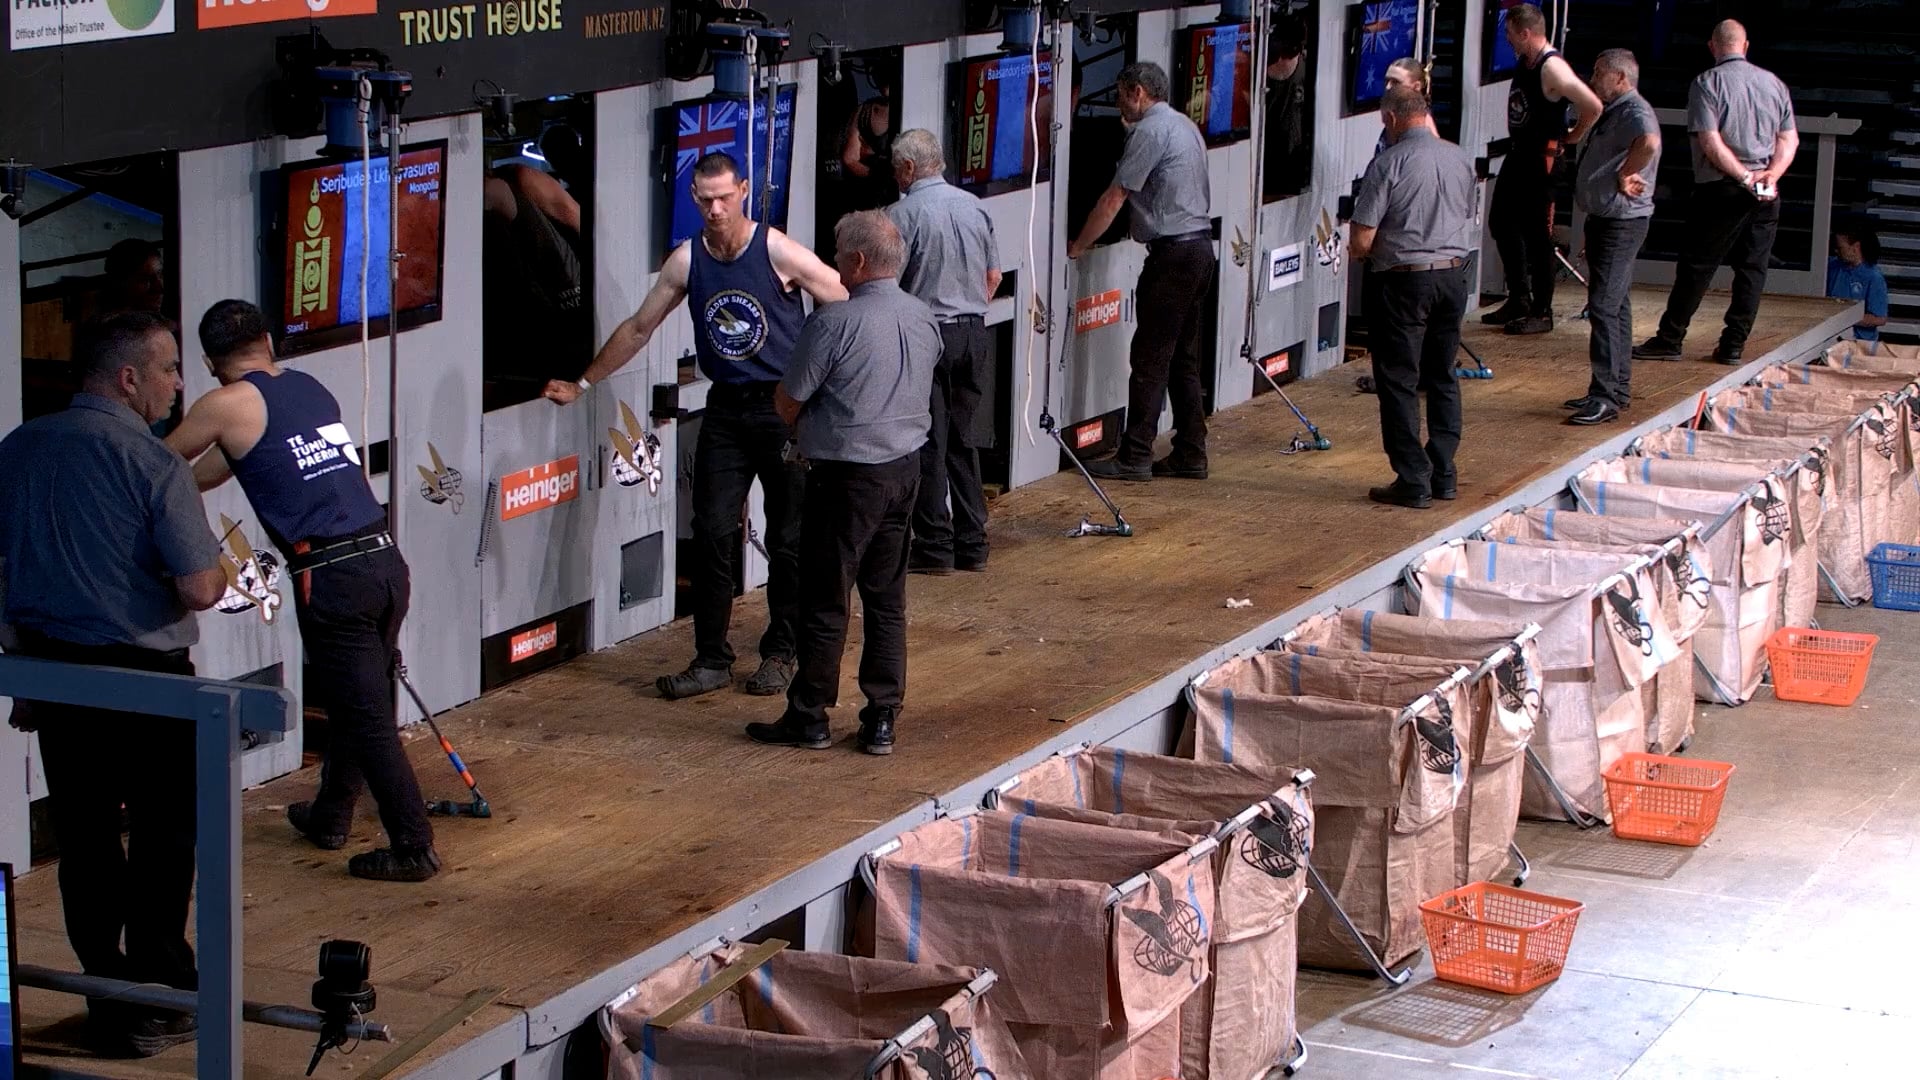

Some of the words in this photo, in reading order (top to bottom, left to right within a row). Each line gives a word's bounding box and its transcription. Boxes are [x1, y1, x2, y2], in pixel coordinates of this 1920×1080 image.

[15, 27, 35, 40] Office
[36, 25, 45, 38] of
[45, 26, 57, 37] the
[79, 21, 105, 33] Trustee
[400, 5, 476, 46] TRUST
[486, 0, 563, 36] HOUSE
[584, 7, 666, 39] MASTERTON.NZ
[738, 103, 766, 121] Haish
[409, 179, 440, 195] Mongolia
[706, 296, 730, 322] GOLDEN
[731, 295, 761, 318] SHEARS
[1078, 294, 1121, 327] Heiniger
[287, 323, 304, 334] Stand
[286, 434, 305, 448] TE
[291, 438, 328, 459] TUMU
[297, 447, 340, 470] PAEROA
[506, 464, 578, 511] Heiniger
[513, 629, 556, 656] Heiniger
